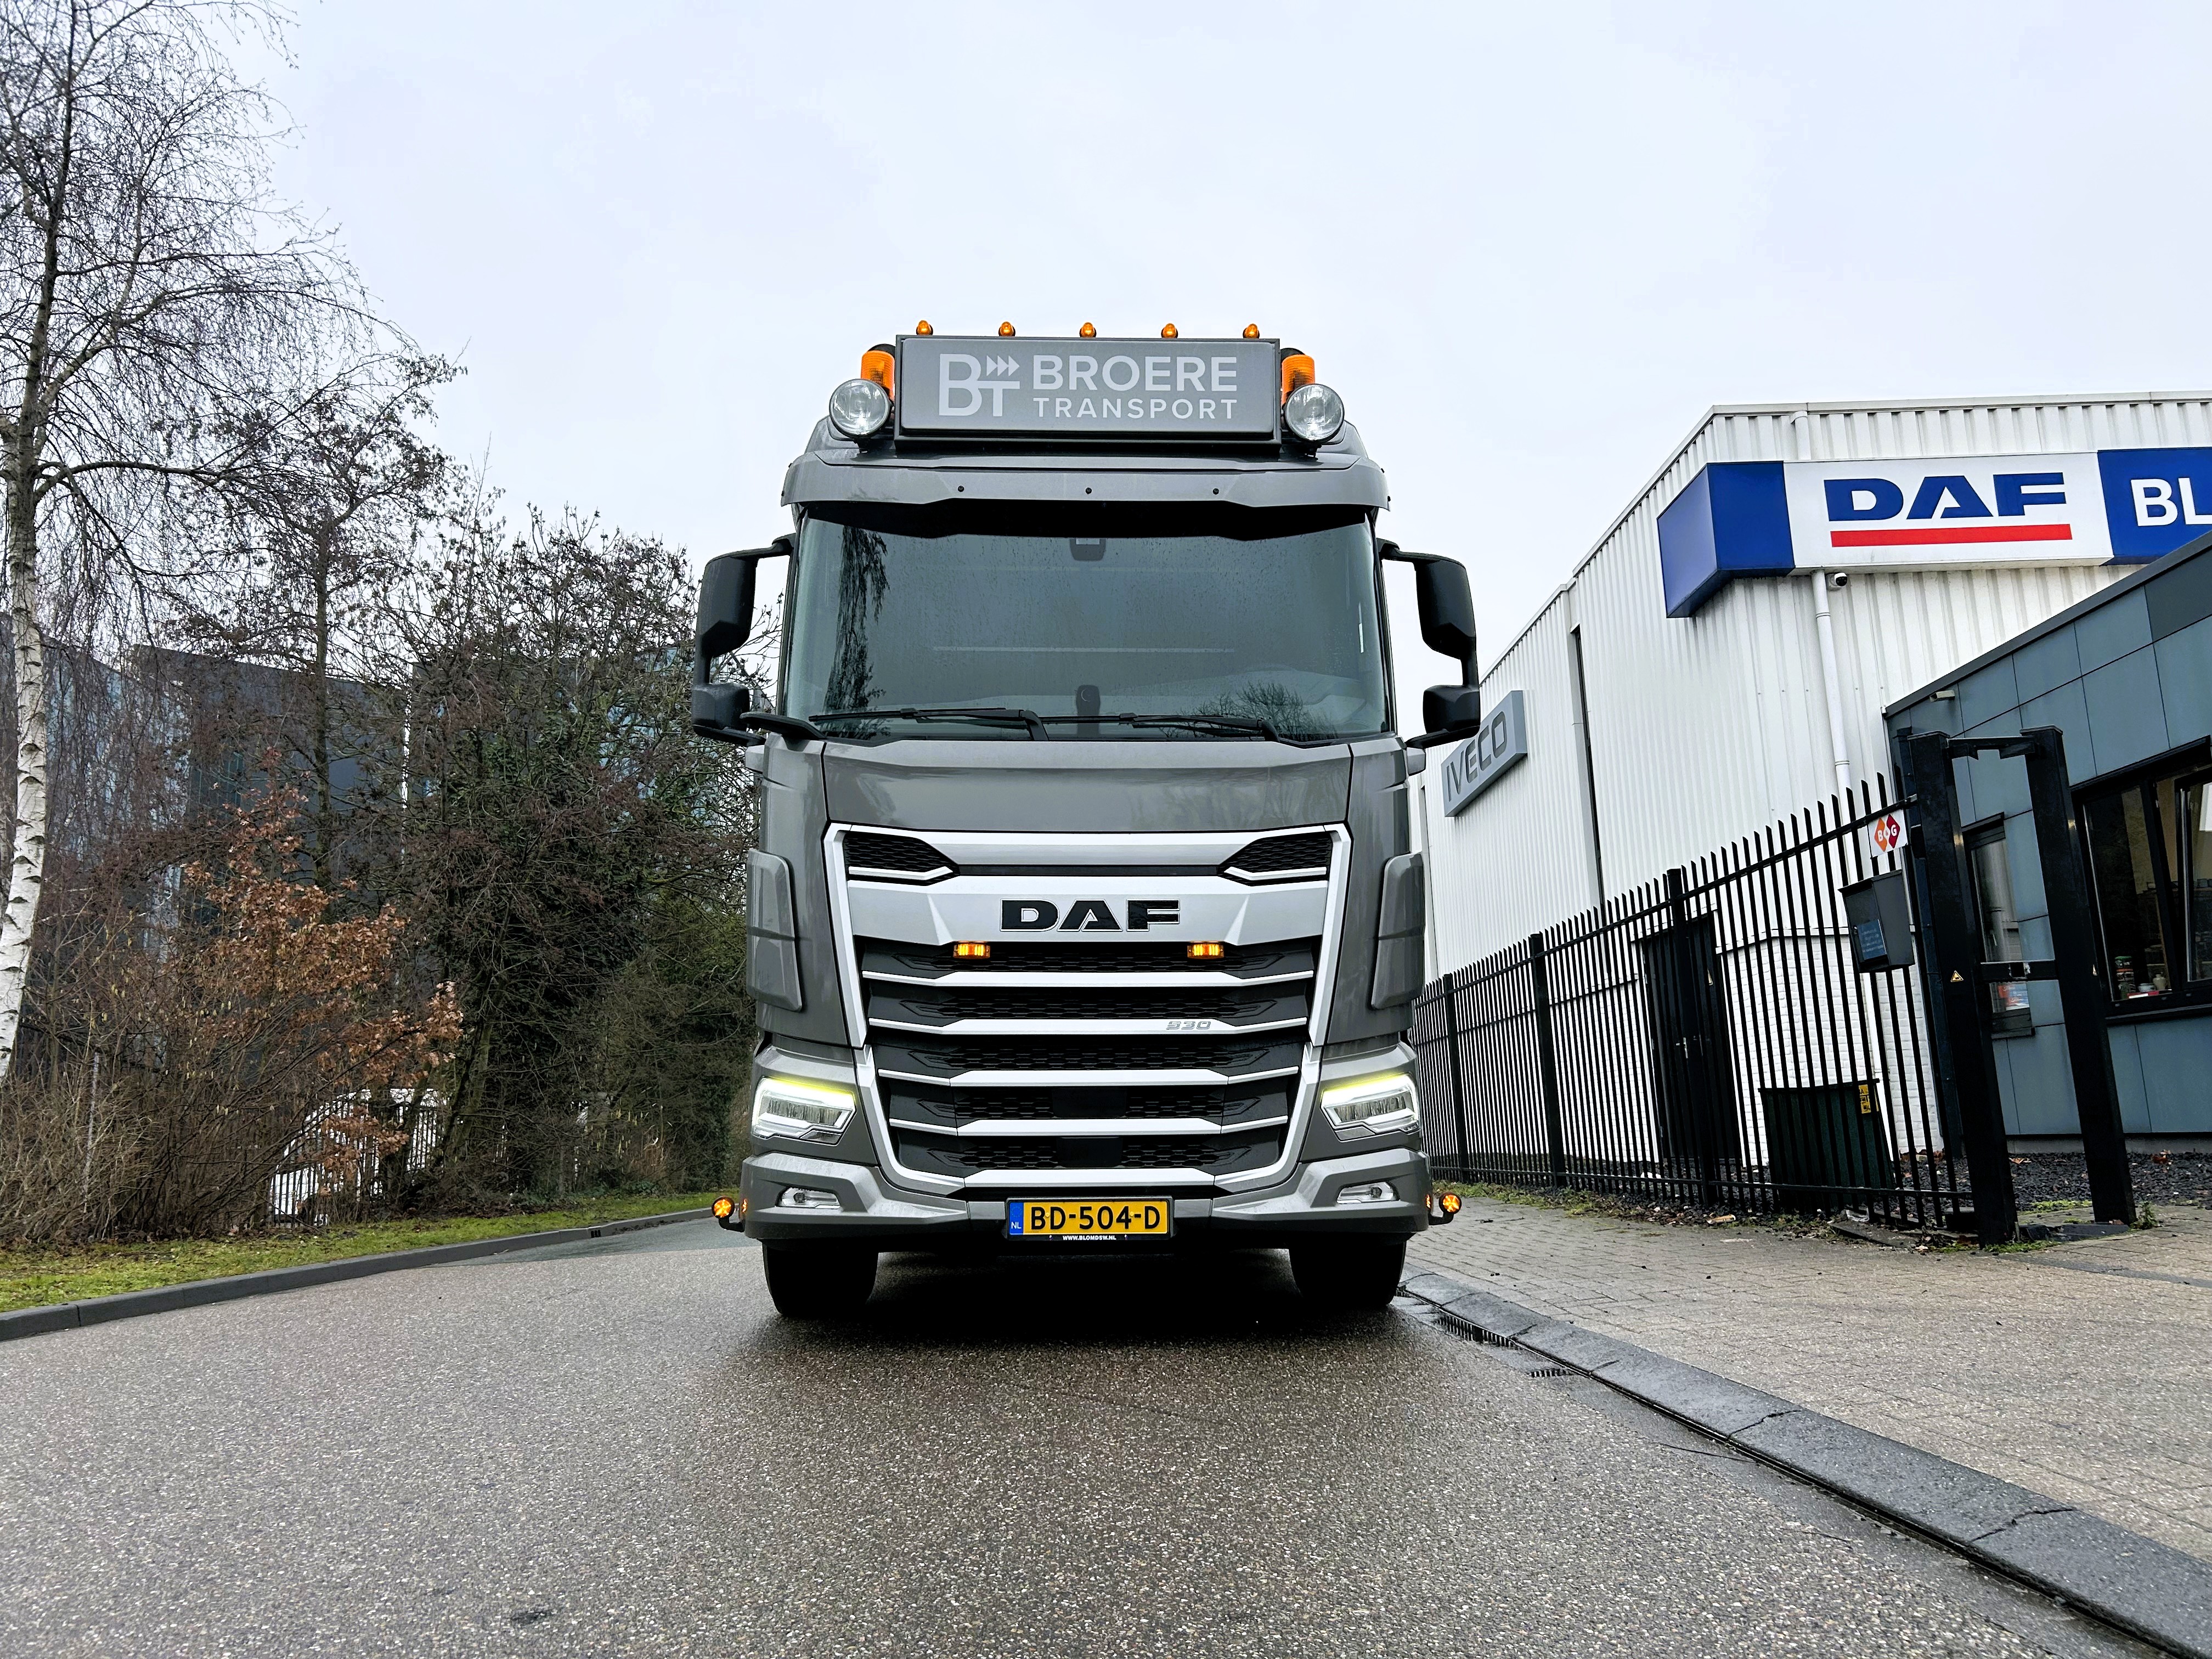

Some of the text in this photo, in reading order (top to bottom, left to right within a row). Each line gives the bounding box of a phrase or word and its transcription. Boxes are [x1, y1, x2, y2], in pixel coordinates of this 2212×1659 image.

[1033, 354, 1238, 392] BROERE
[1034, 397, 1238, 419] TRANSPORT
[1823, 472, 2067, 522] DAF
[1447, 711, 1508, 802] IVECO
[1000, 899, 1180, 932] DAF
[1166, 1021, 1211, 1030] 530
[1011, 1221, 1022, 1230] NL
[1030, 1206, 1161, 1230] BD-504-D
